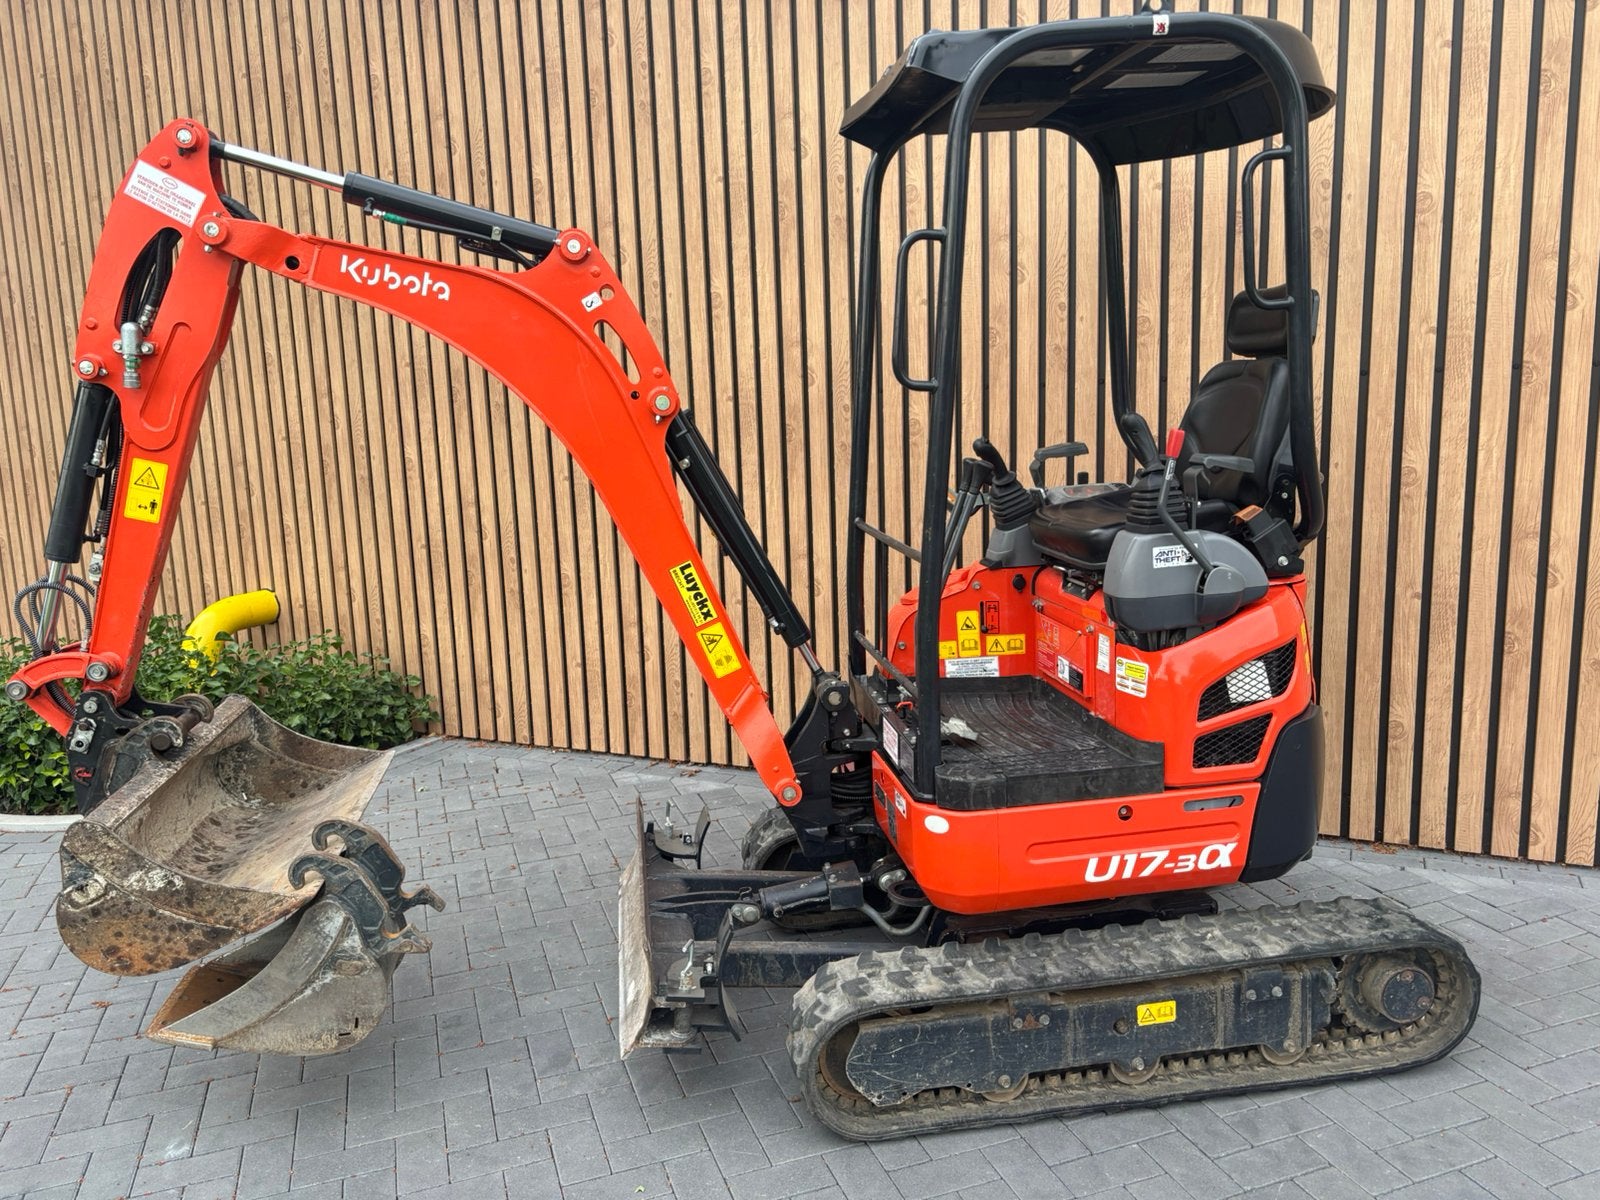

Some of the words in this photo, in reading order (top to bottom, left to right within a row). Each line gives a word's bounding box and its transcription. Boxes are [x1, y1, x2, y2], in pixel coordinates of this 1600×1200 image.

[340, 254, 450, 301] Kubota
[672, 570, 684, 588] BRECHT
[678, 563, 714, 621] Luyckx
